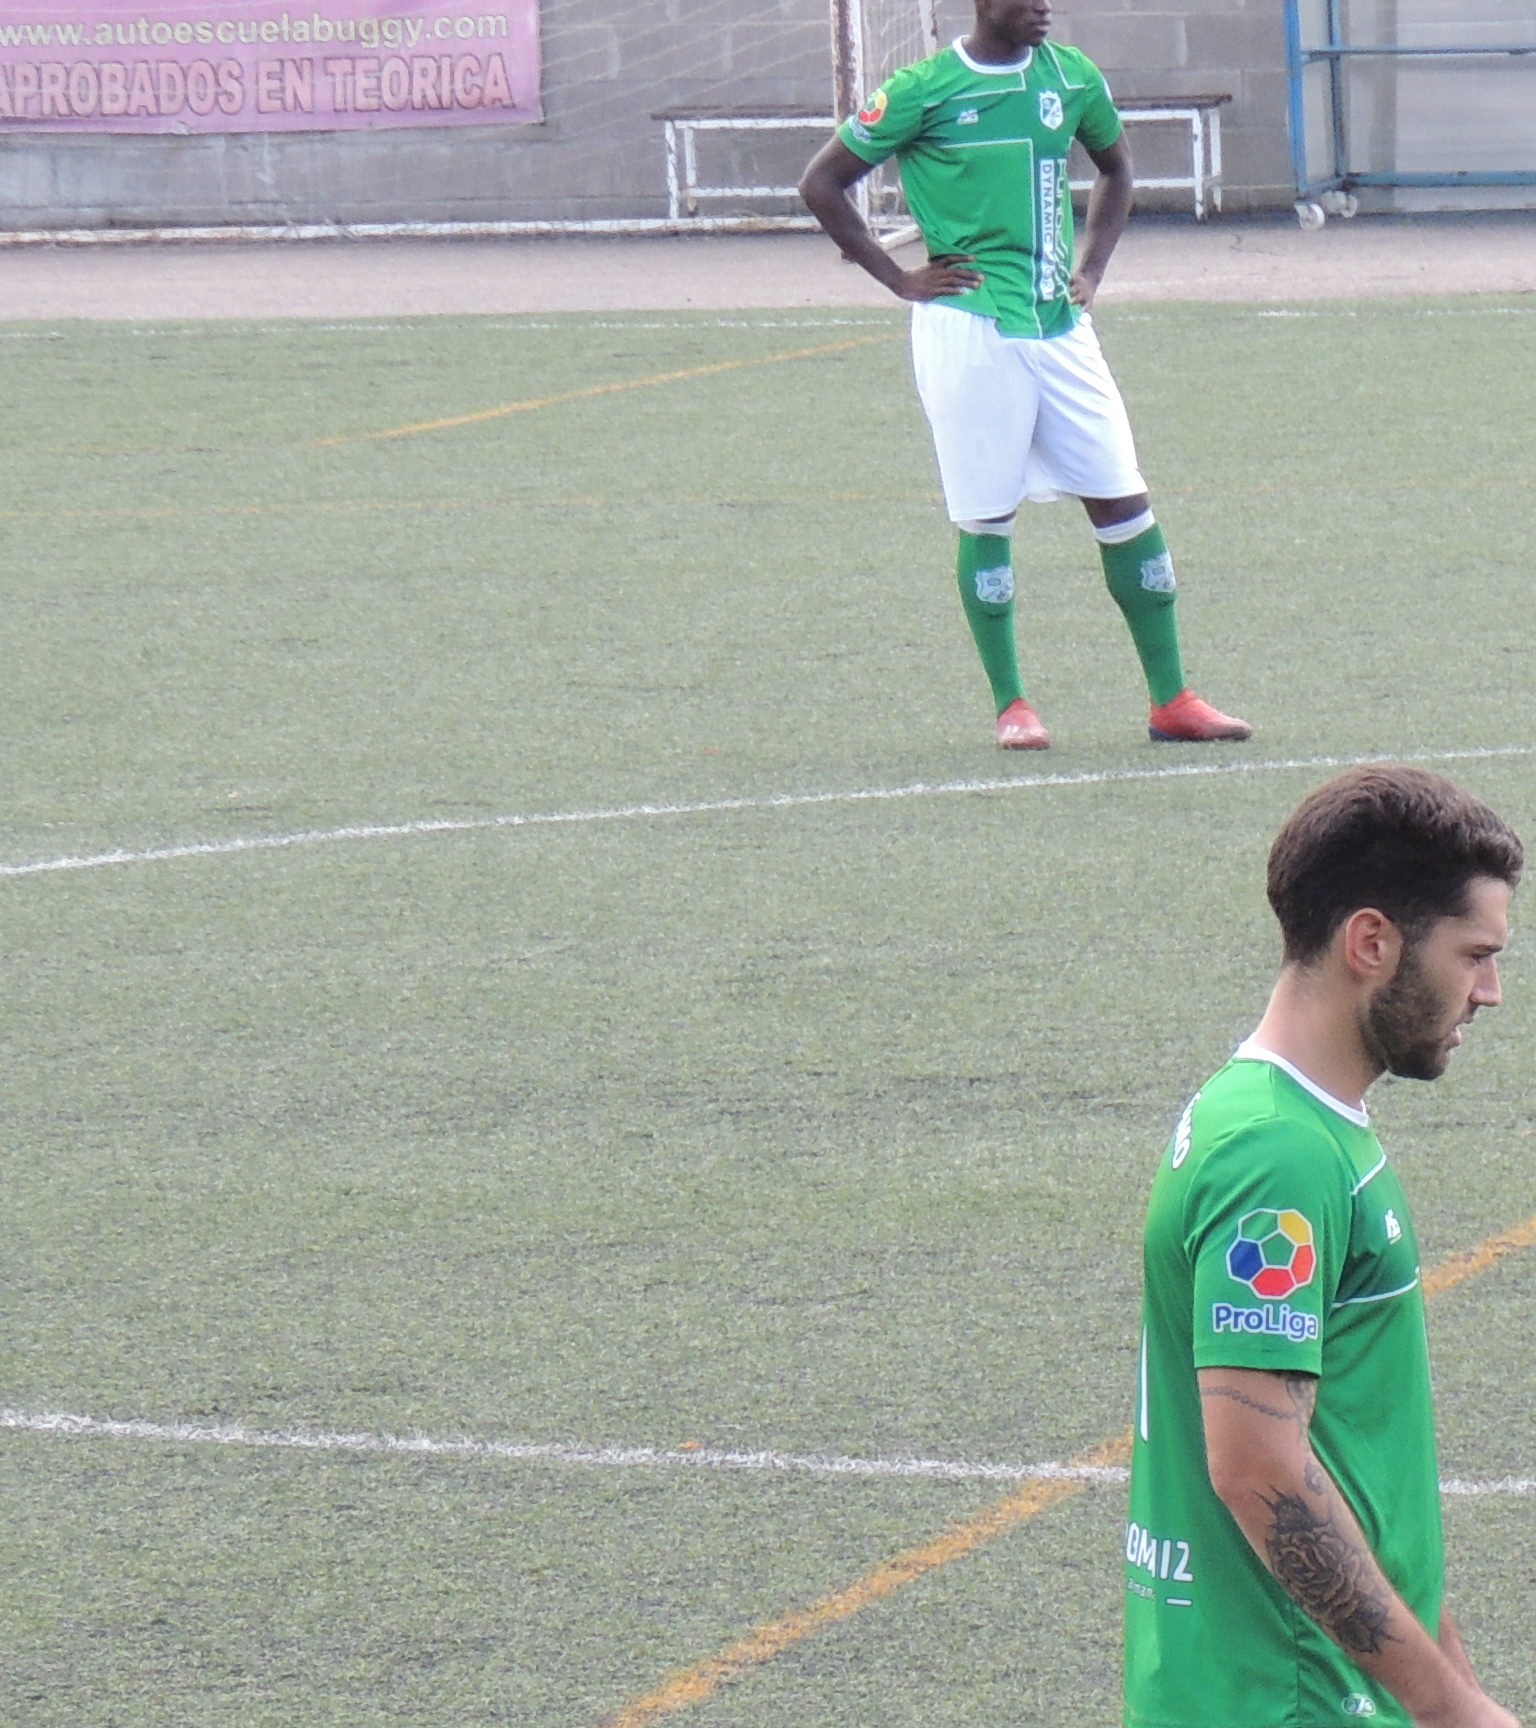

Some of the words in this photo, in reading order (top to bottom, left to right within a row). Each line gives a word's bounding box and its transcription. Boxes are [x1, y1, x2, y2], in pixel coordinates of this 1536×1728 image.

[0, 13, 508, 48] www.autoescuelabuggy.com
[257, 58, 315, 113] EN
[324, 53, 515, 111] TEORICA
[1042, 163, 1053, 244] DYNAMIC
[1212, 1303, 1318, 1341] ProLiga
